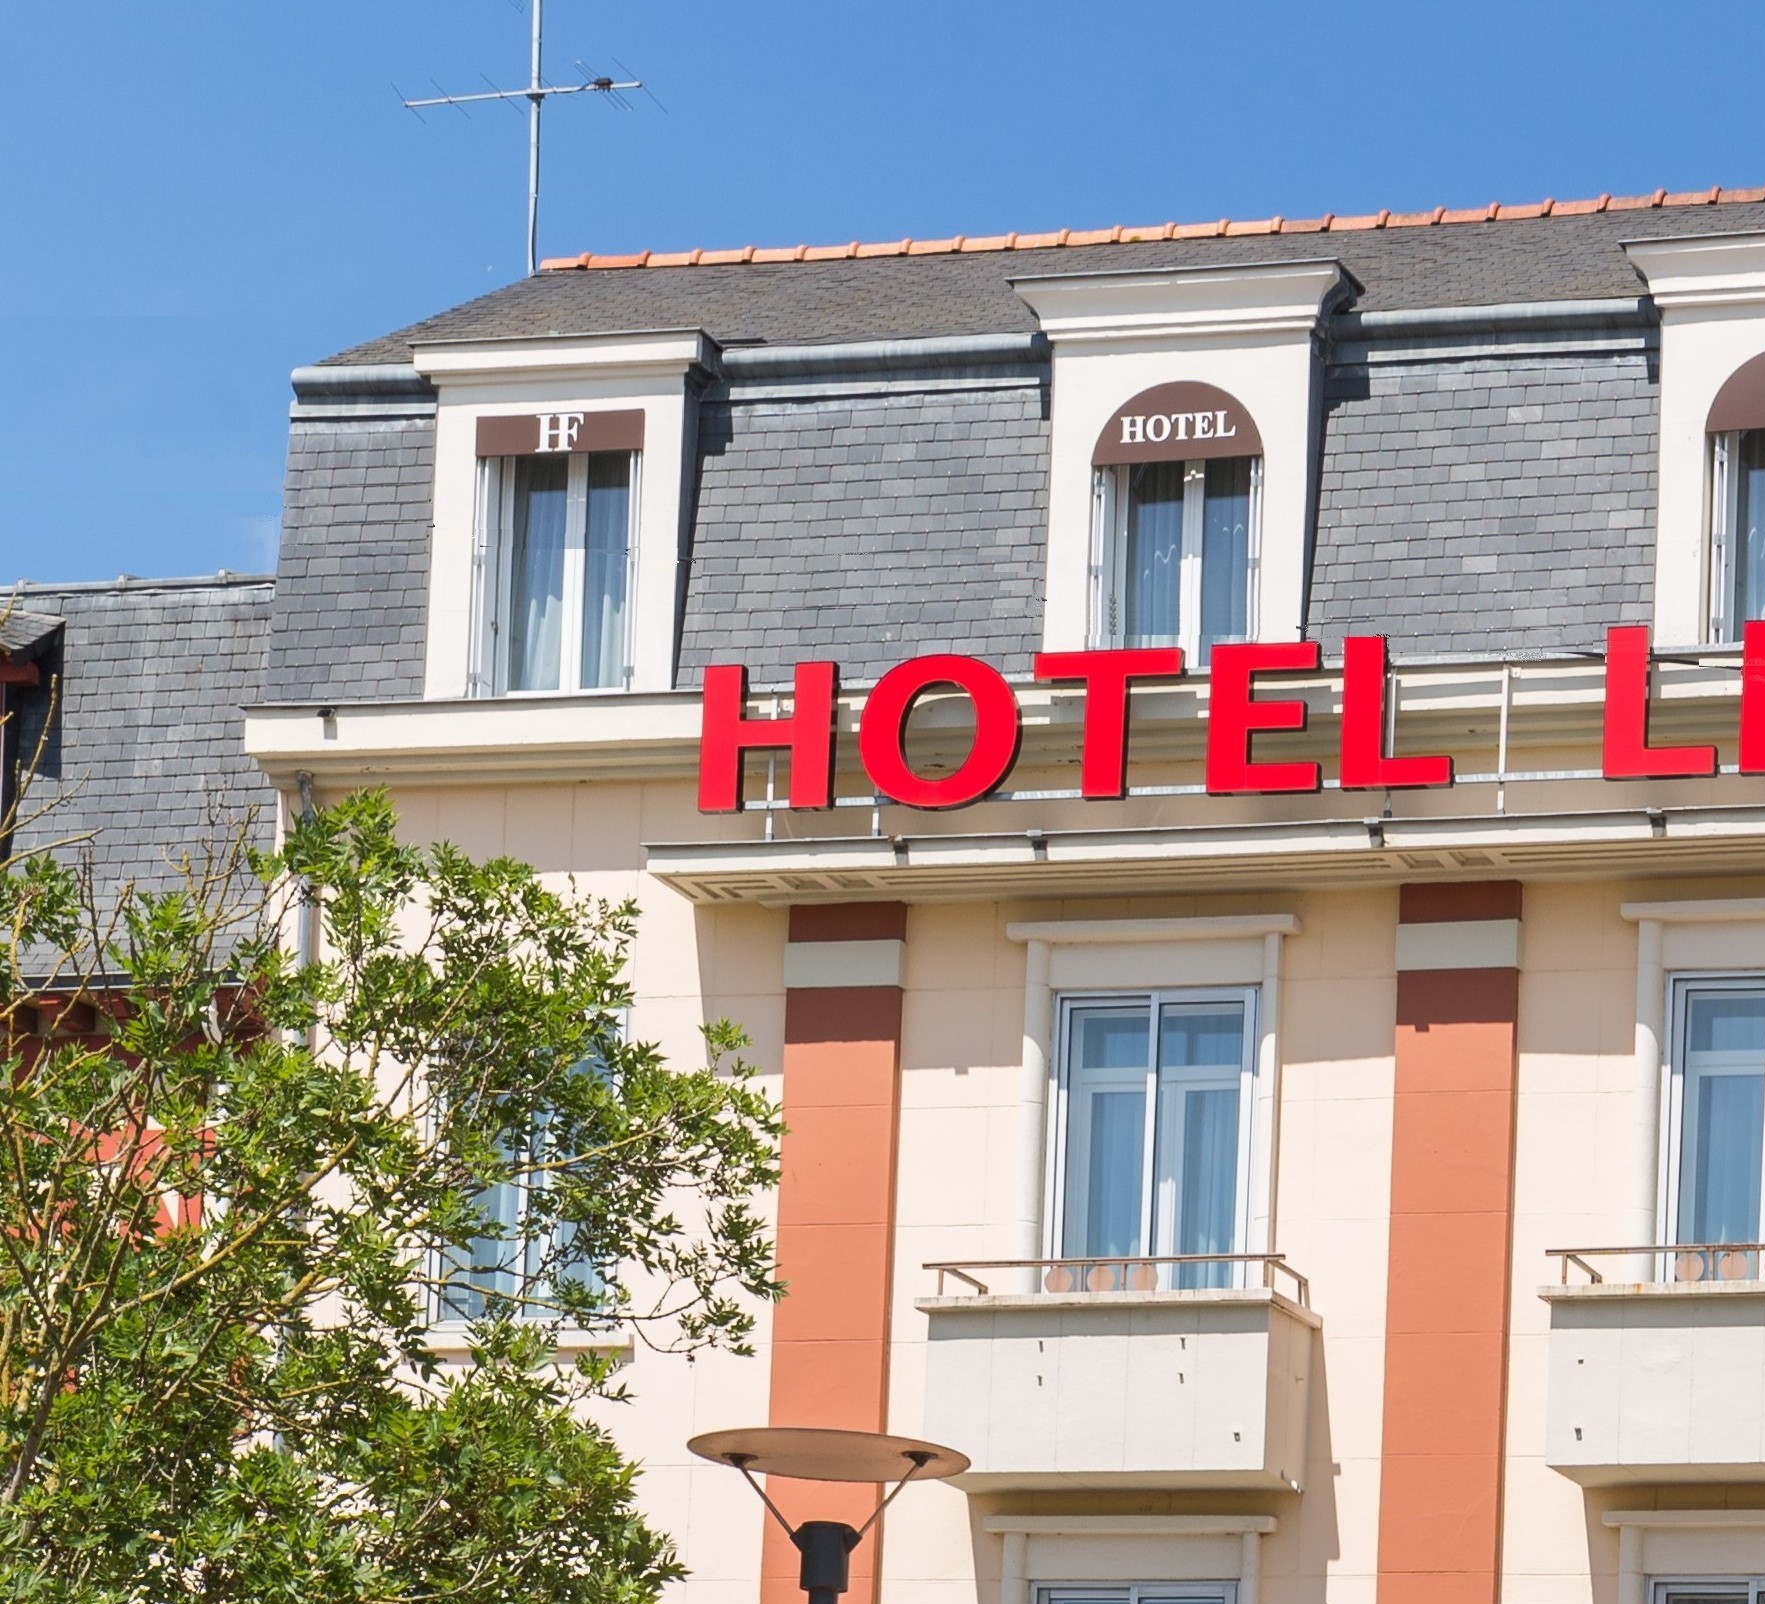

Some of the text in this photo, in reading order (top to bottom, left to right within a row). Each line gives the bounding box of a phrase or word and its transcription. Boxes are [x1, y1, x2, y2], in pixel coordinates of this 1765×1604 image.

[535, 412, 584, 452] HF
[1120, 410, 1236, 443] HOTEL
[698, 636, 1455, 813] HOTEL
